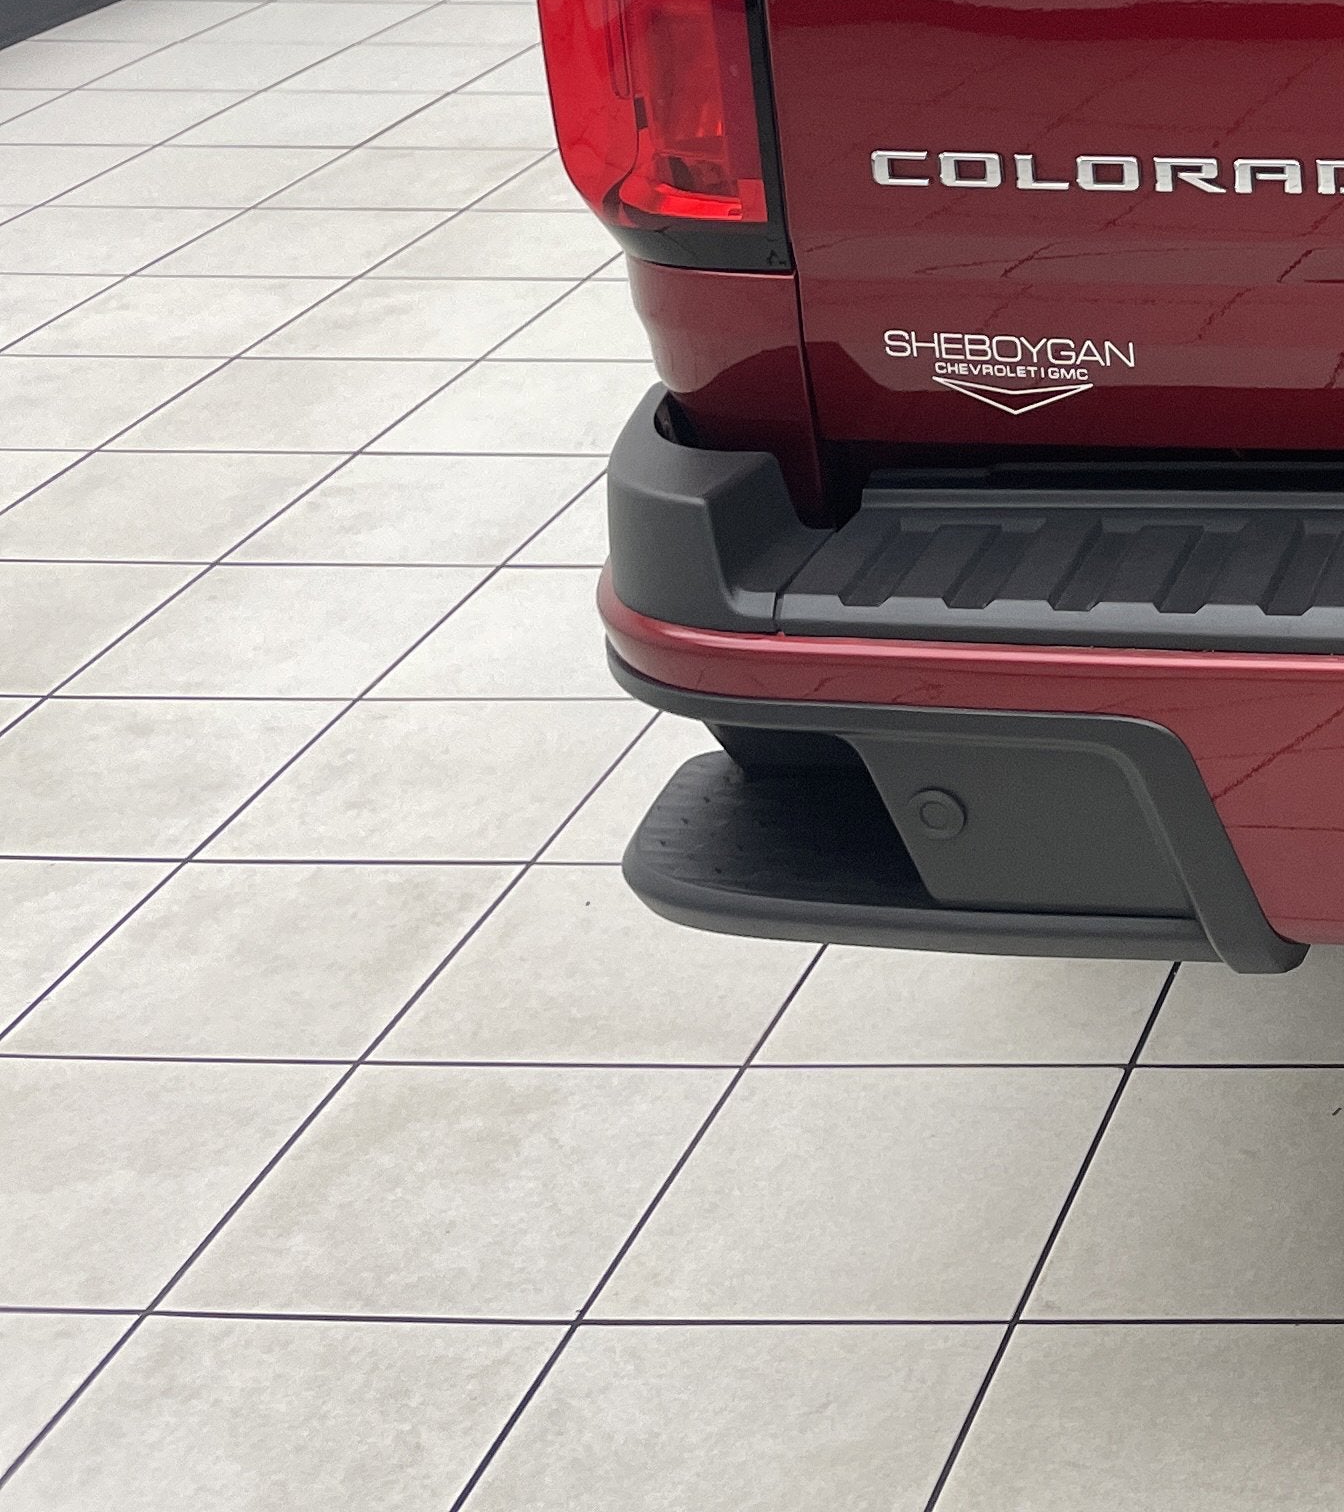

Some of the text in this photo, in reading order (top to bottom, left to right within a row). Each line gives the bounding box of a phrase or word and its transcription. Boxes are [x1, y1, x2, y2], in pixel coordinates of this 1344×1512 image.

[883, 329, 1136, 368] SHEBOYGAN
[934, 361, 1089, 381] CHEVROLET GMC
